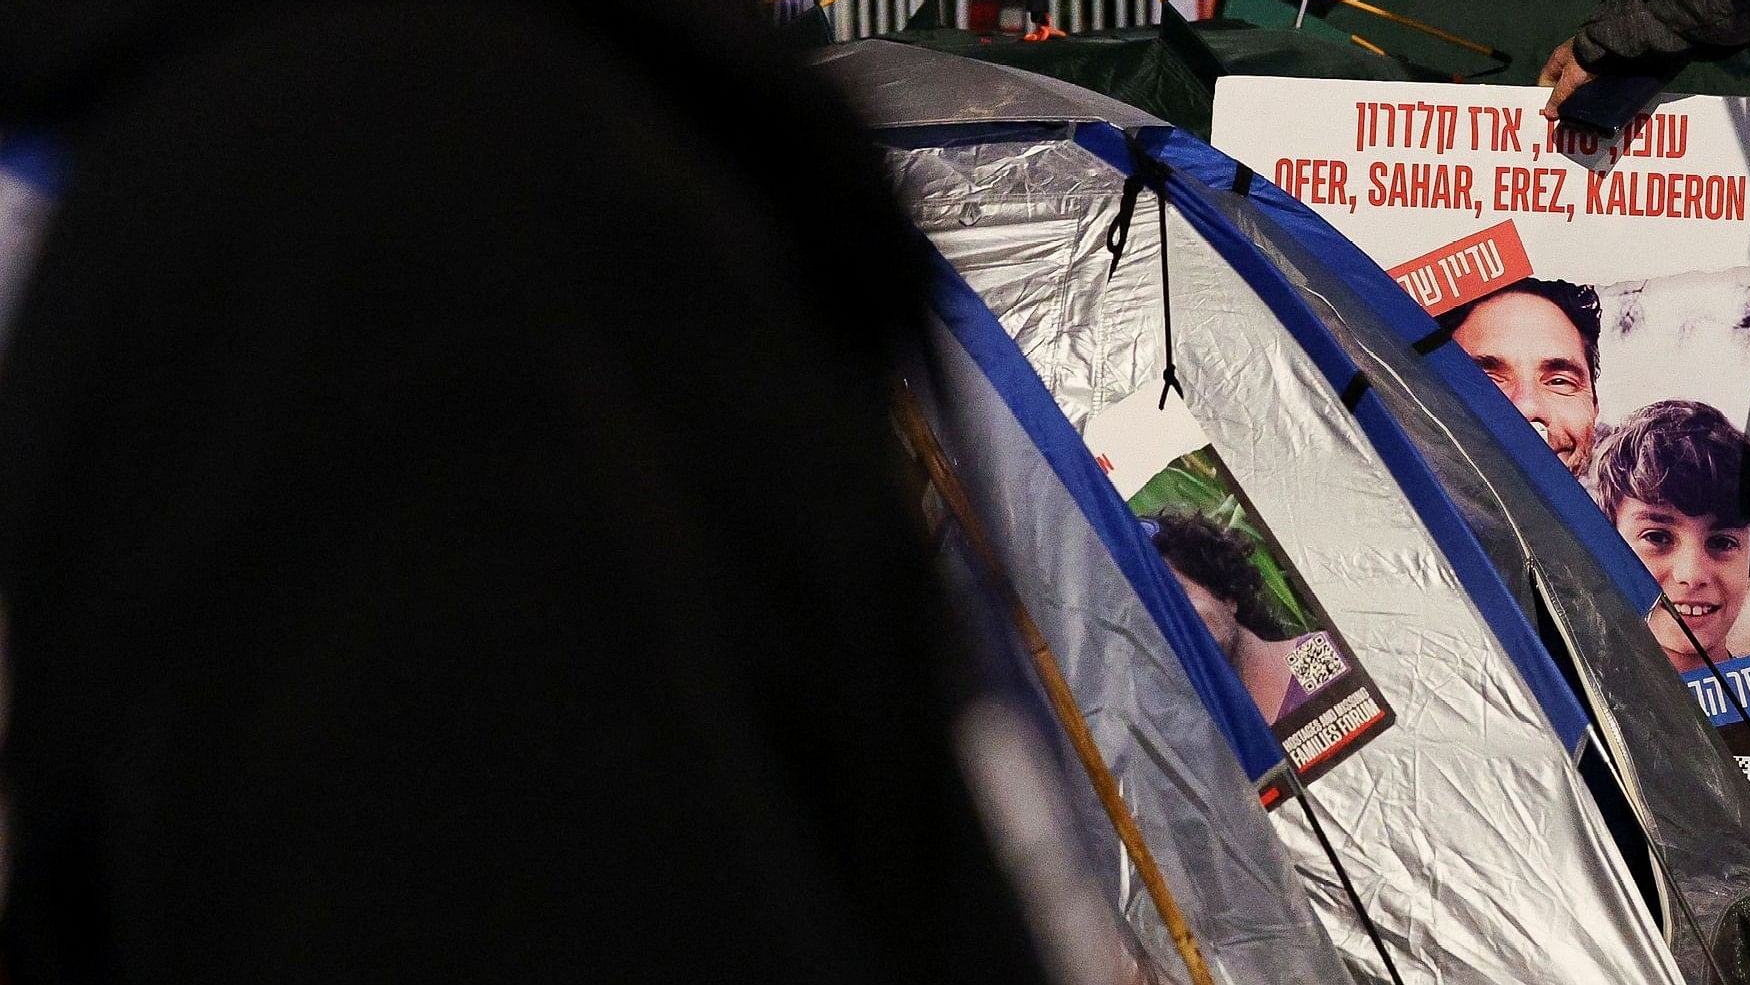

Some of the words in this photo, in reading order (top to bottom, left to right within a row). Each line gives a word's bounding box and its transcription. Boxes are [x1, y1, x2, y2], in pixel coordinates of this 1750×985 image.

[1356, 101, 1460, 155] קלדרון
[1468, 106, 1521, 152] ארז
[1274, 158, 1358, 215] OFER,
[1367, 161, 1482, 219] SAHAR,
[1493, 165, 1576, 223] EREZ,
[1586, 170, 1746, 222] KALDERON
[1437, 238, 1506, 299] עדיין
[1289, 723, 1343, 769] FAMILIES
[1336, 697, 1382, 737] FORUM
